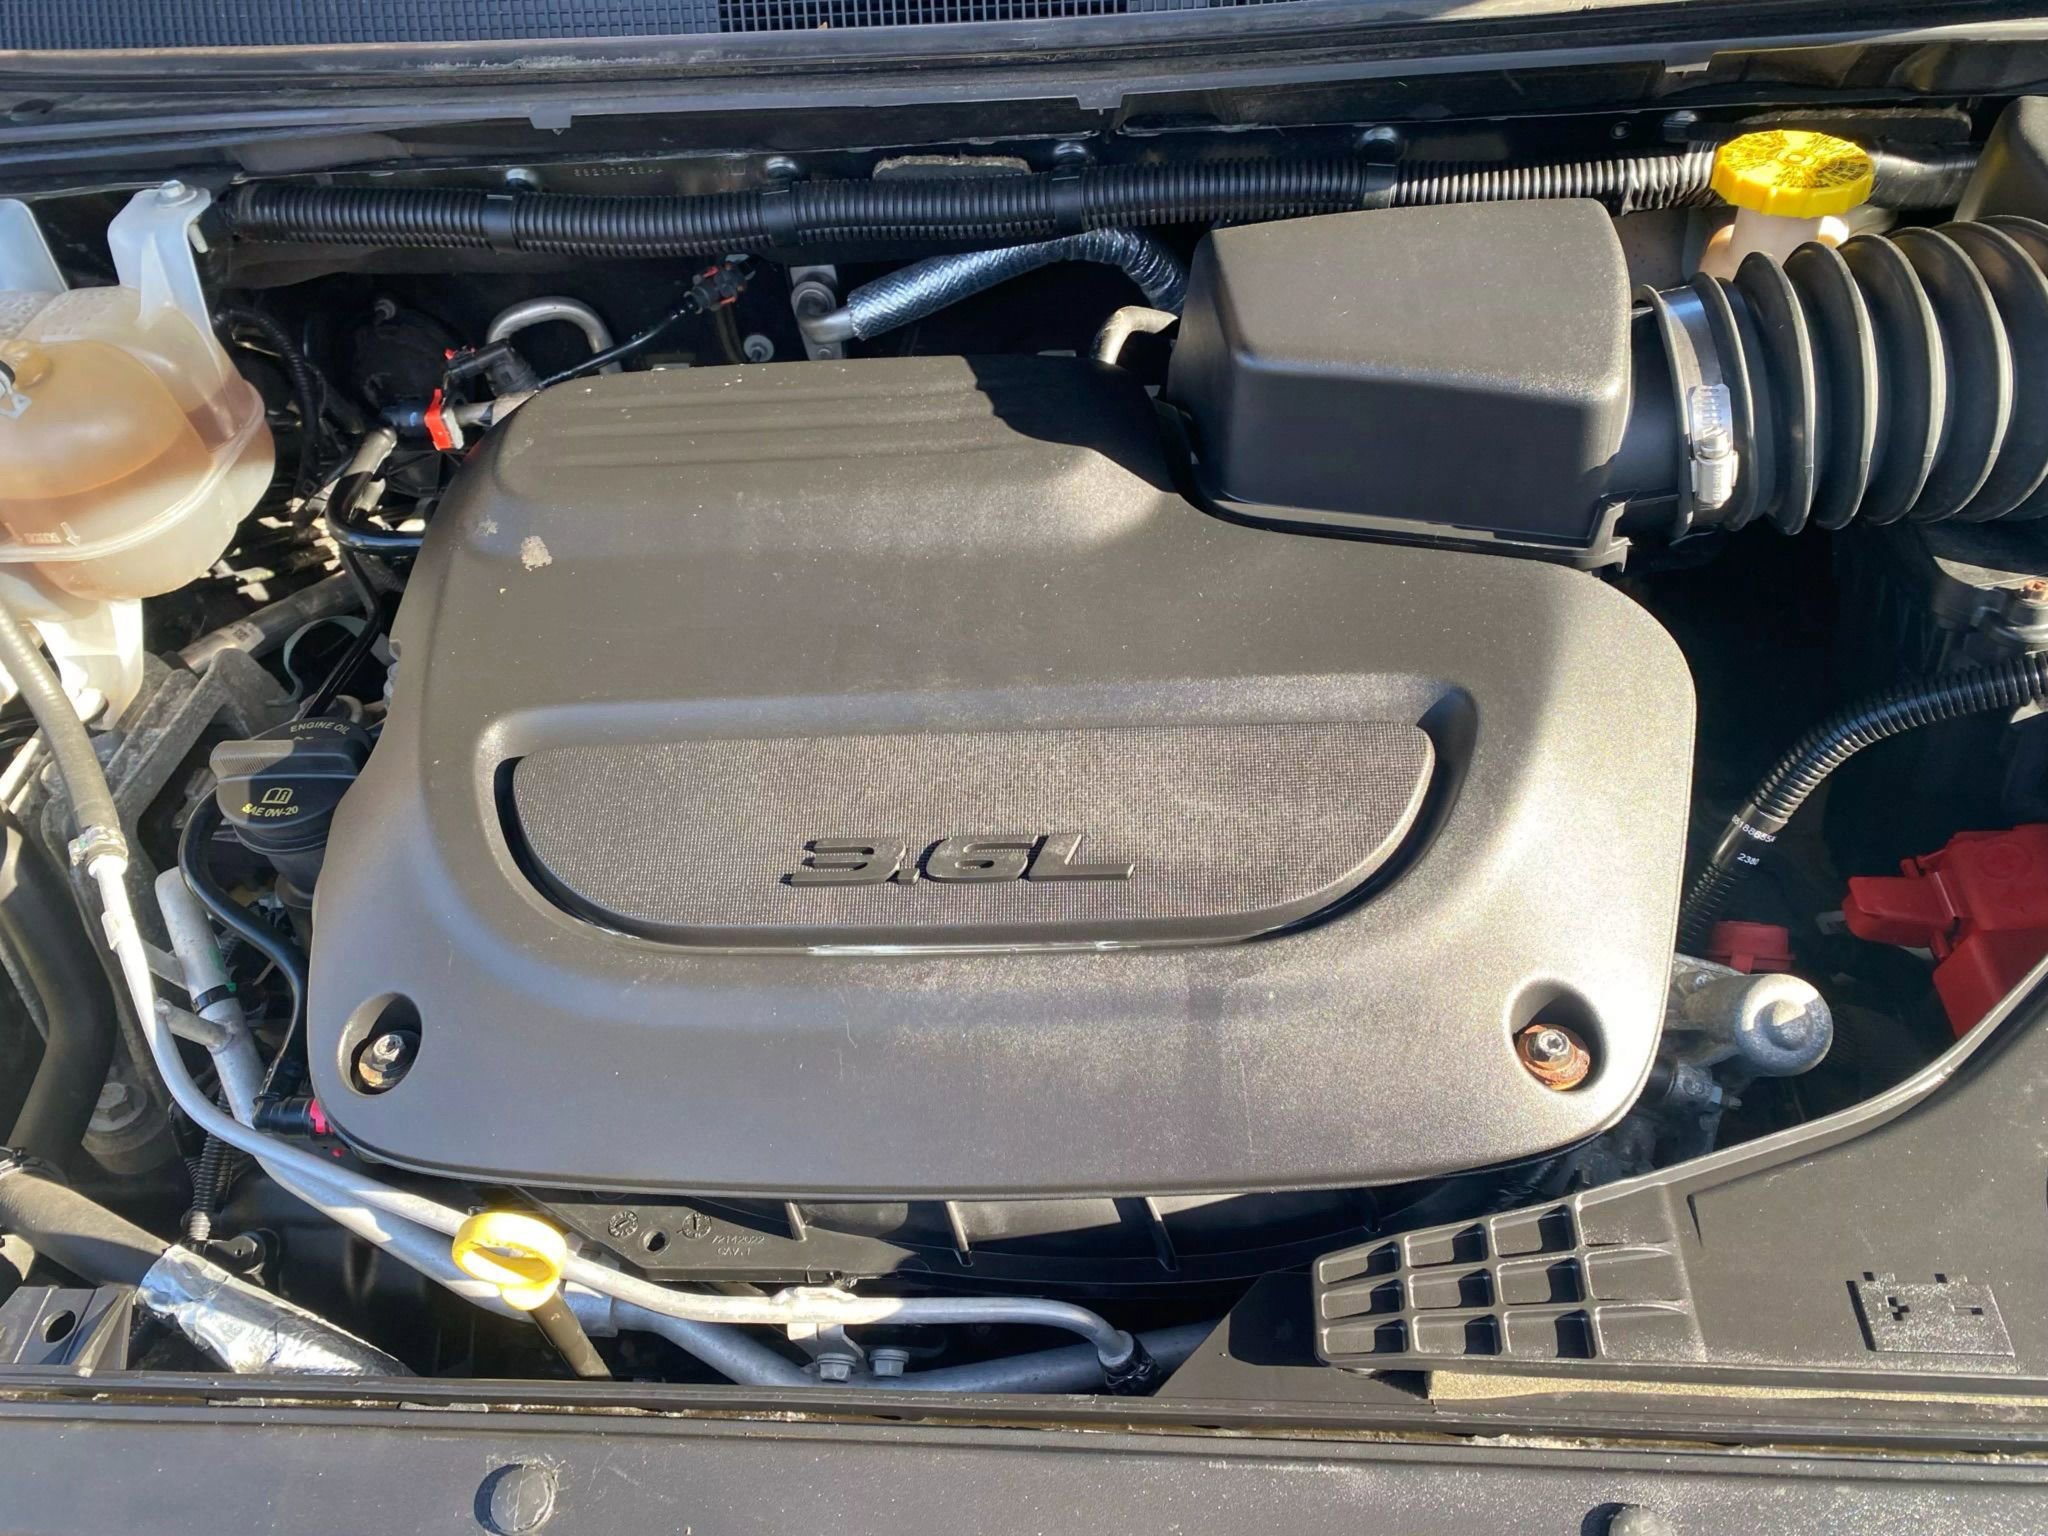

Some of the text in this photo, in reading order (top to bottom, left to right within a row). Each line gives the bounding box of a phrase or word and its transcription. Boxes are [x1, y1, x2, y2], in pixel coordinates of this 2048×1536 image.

[290, 720, 351, 735] ENGINE OIL
[242, 802, 299, 818] SAE 0W-20
[786, 832, 1136, 888] 3.6L
